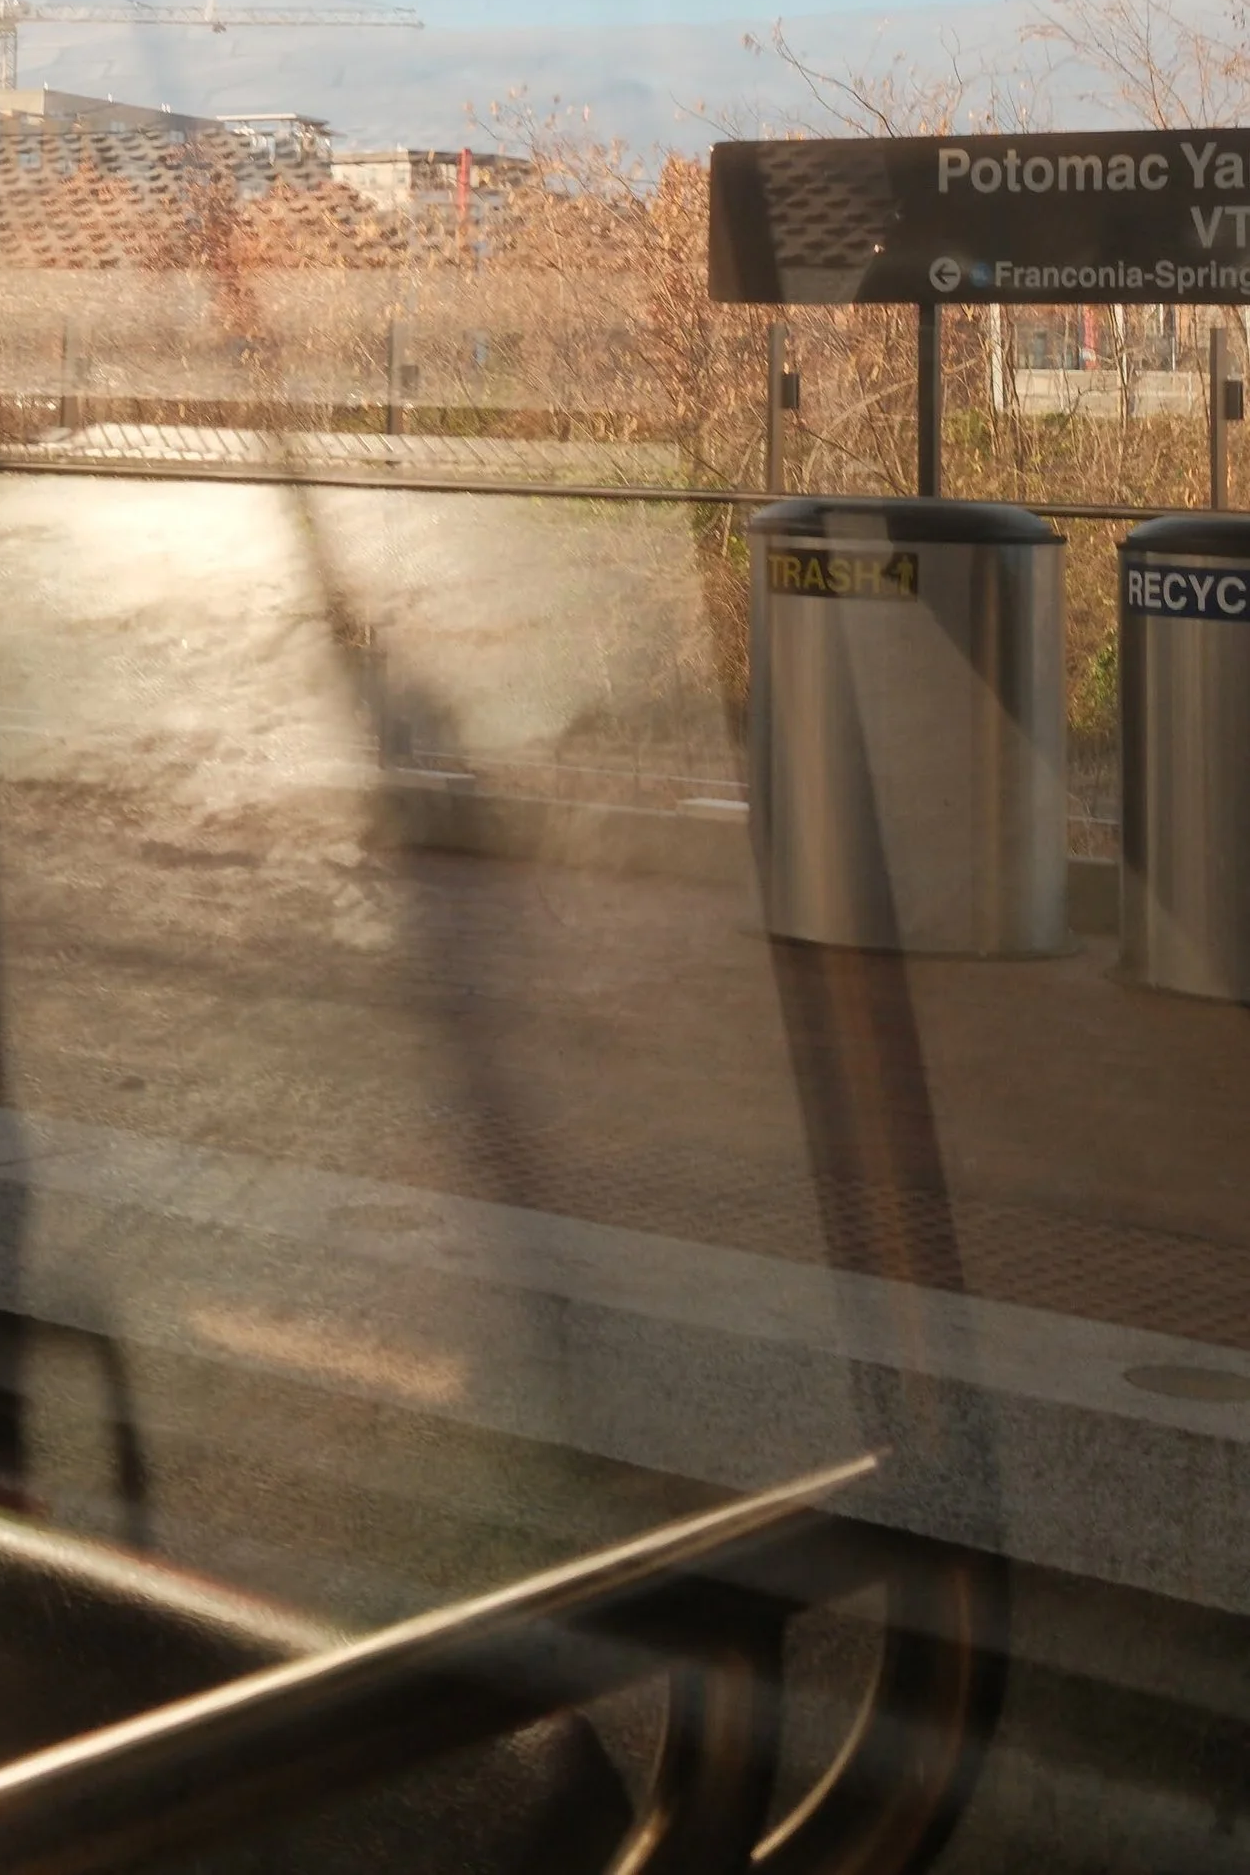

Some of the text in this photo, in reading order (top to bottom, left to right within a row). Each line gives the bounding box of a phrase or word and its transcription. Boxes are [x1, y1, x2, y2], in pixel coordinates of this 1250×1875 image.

[937, 141, 1250, 194] Potomac Ya
[767, 554, 882, 594] TRASH
[1128, 569, 1247, 614] RECYC
